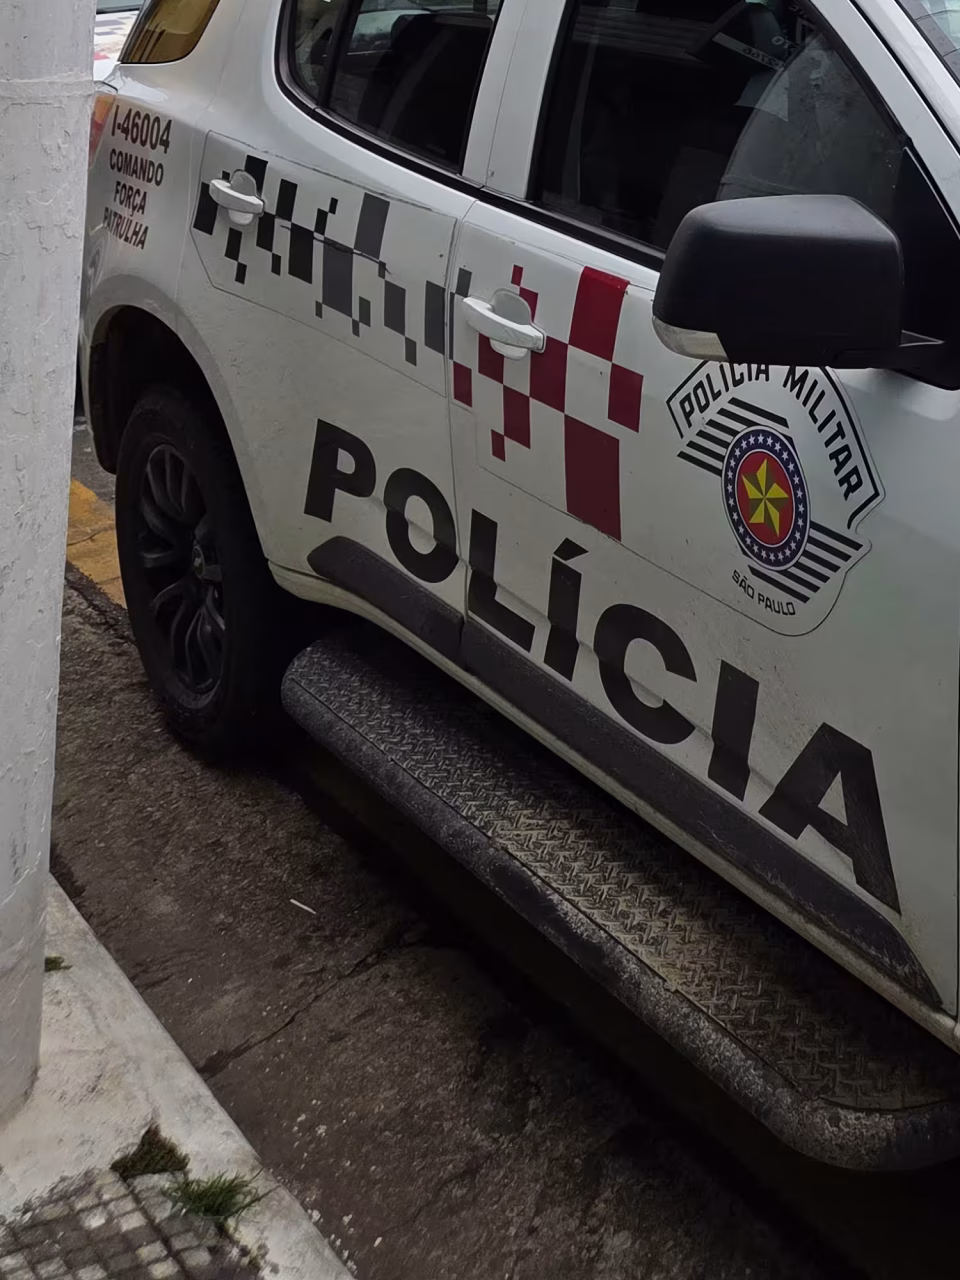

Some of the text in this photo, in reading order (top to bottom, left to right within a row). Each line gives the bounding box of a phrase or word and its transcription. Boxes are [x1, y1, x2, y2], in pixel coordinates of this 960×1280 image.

[111, 105, 172, 154] I-46004
[110, 148, 164, 187] COMANDO
[114, 180, 147, 217] FORÇA
[103, 206, 149, 250] PATRULHA
[782, 365, 863, 501] MILITAR
[731, 569, 796, 616] SÃO PAULO
[303, 418, 903, 918] POLÍCIA
